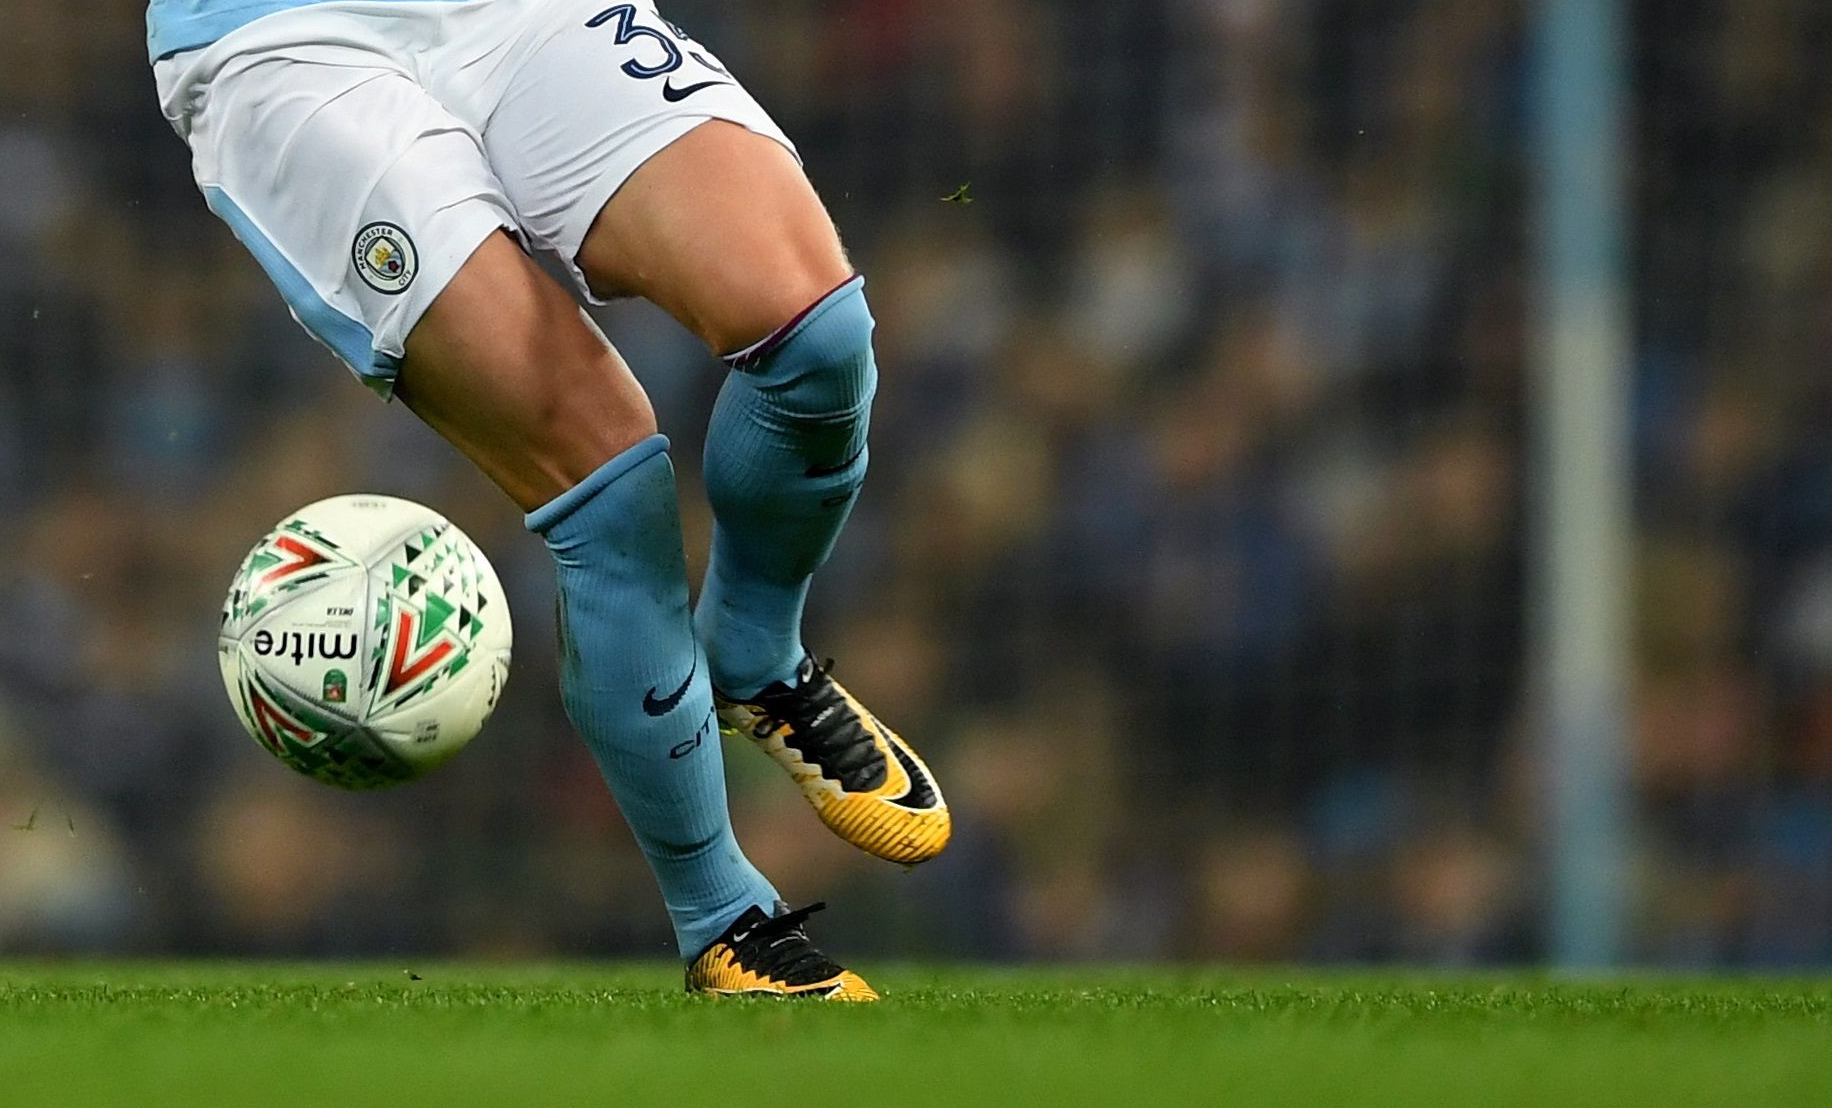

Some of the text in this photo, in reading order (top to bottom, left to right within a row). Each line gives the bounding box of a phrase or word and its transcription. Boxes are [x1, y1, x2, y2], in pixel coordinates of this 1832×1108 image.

[357, 227, 394, 270] MANCHESTER
[398, 269, 412, 287] CITY
[254, 630, 358, 666] mitre
[670, 706, 715, 759] CIT
